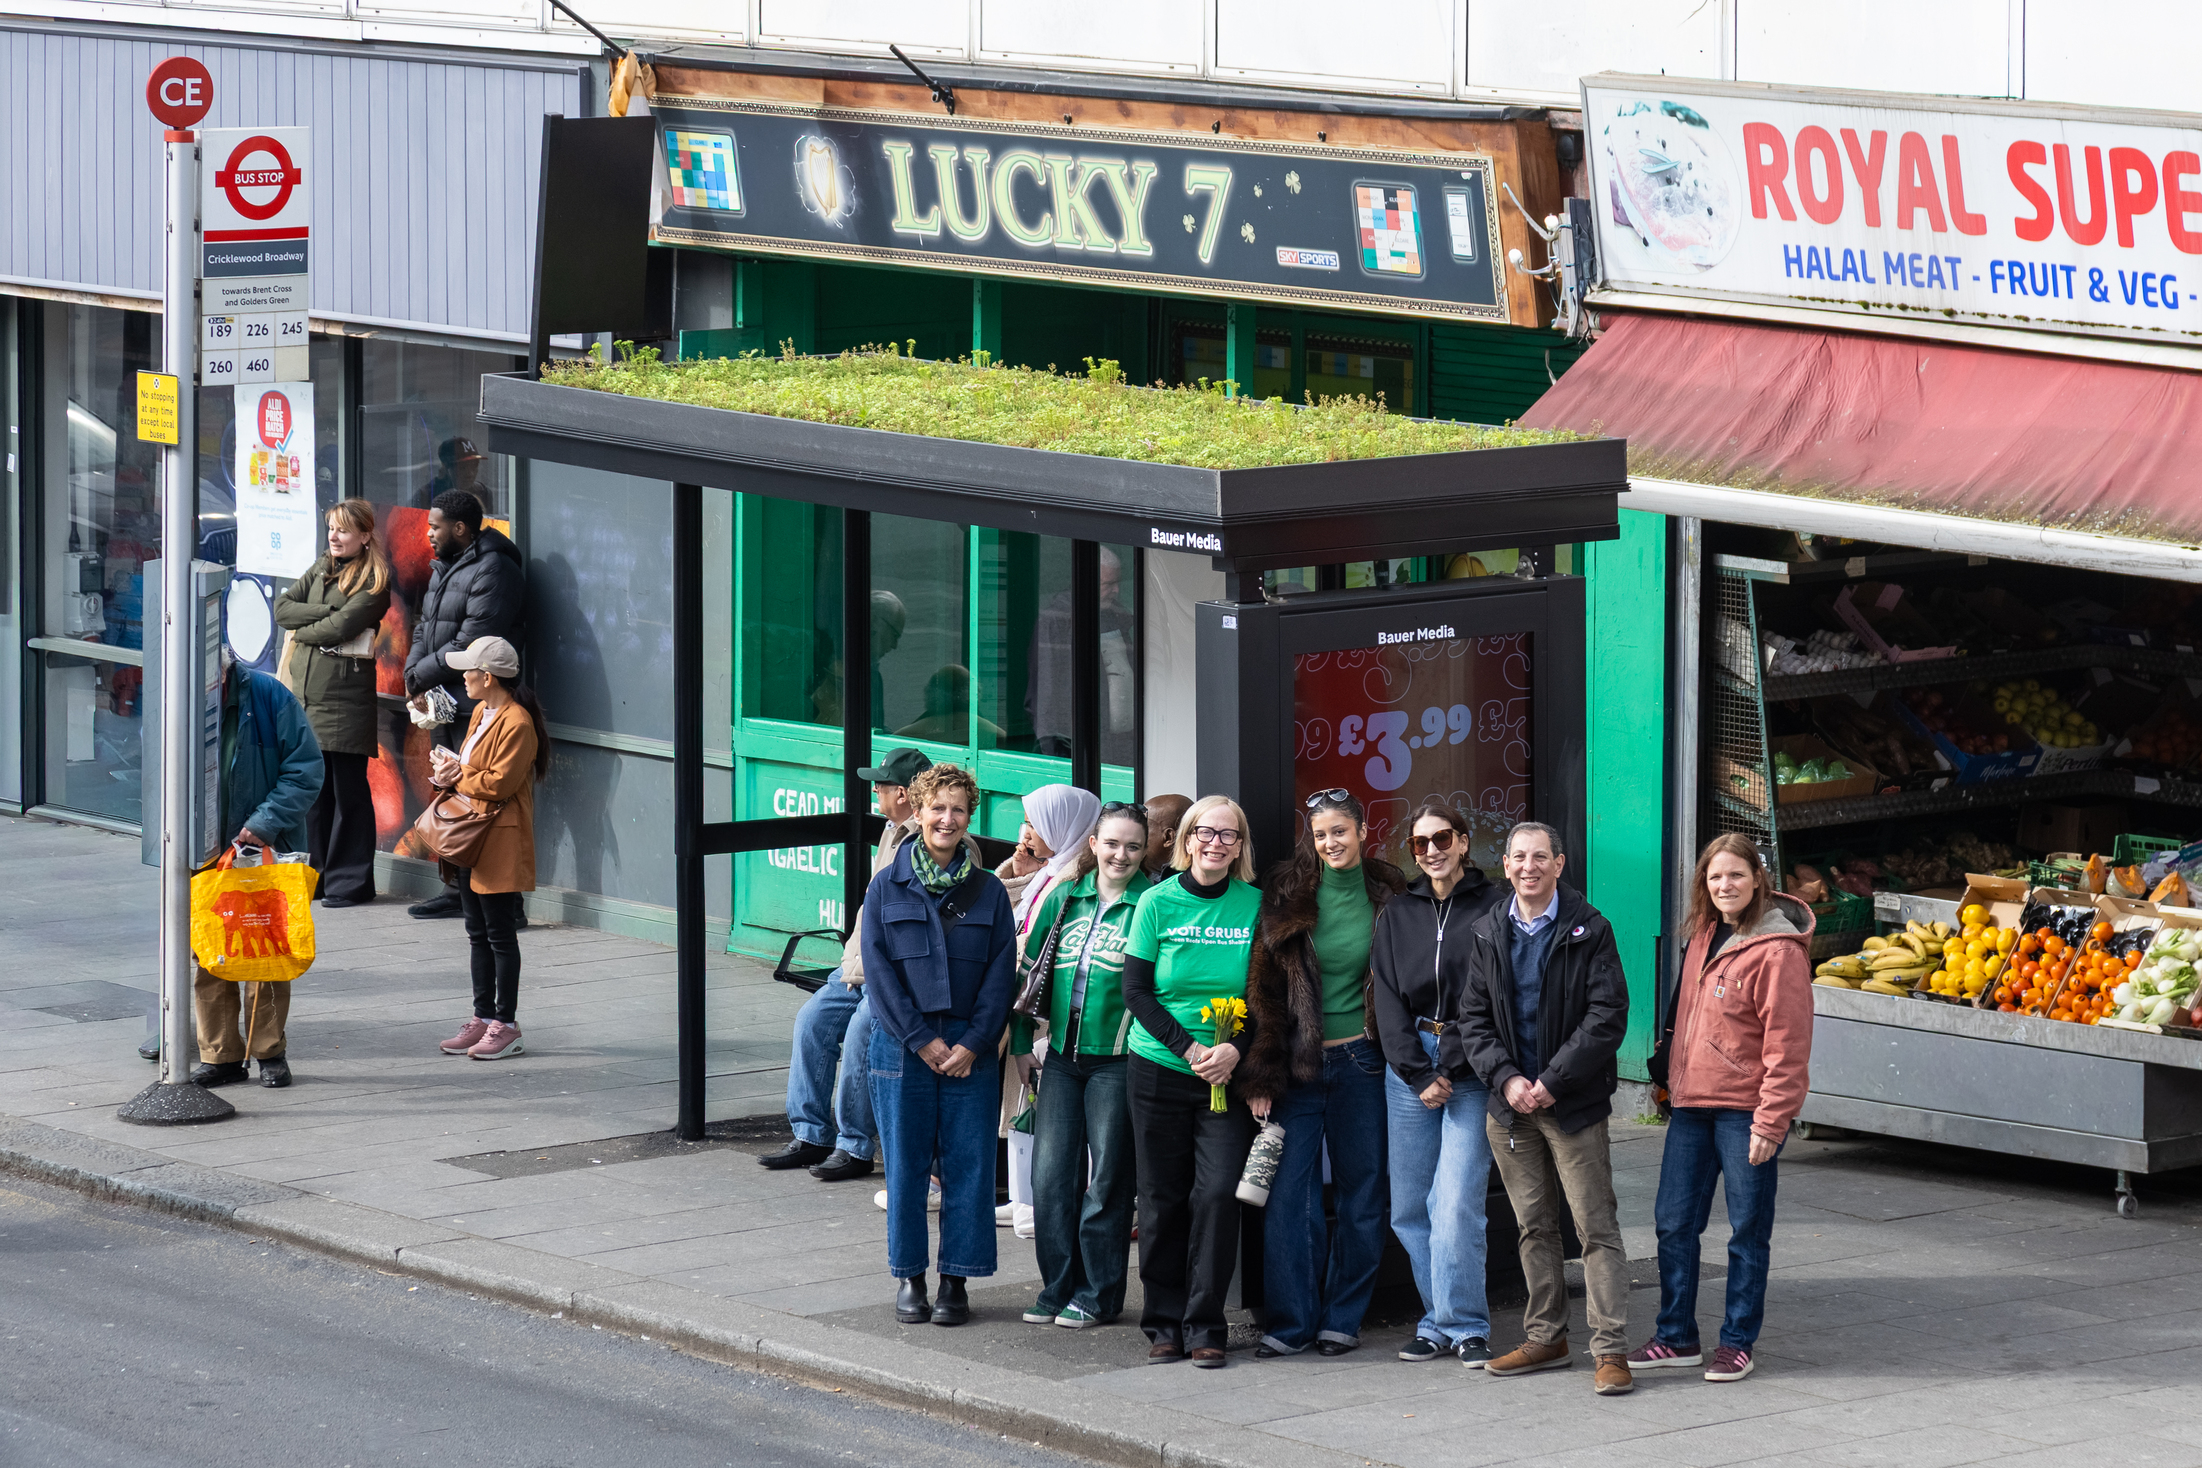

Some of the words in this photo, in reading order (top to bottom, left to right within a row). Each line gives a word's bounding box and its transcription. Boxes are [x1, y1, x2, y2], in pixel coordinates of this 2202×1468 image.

[160, 77, 203, 107] CE
[234, 172, 255, 184] BUS
[257, 171, 285, 184] STOP
[1741, 121, 1987, 236] ROYAL
[2006, 139, 2202, 254] SUPE
[883, 141, 1156, 256] LUCKY
[1186, 165, 1231, 263] 7
[207, 253, 263, 265] Cricklewood
[264, 251, 305, 264] Broadway
[1280, 251, 1297, 262] SKY
[1299, 252, 1337, 266] SPORTS
[1783, 243, 1875, 285] HALAL
[1883, 251, 1962, 292] MEAT
[1990, 259, 2077, 299] FRUIT
[2089, 266, 2111, 303] &
[2118, 270, 2180, 309] VEG
[222, 286, 251, 295] towards
[252, 286, 272, 294] Brent
[272, 285, 292, 293] Cross
[224, 298, 239, 306] and
[240, 298, 267, 306] Golders
[268, 296, 290, 304] Green
[210, 325, 232, 337] 189
[246, 323, 269, 336] 226
[281, 321, 303, 335] 245
[209, 360, 233, 373] 260
[246, 358, 269, 371] 460
[140, 389, 149, 399] No
[150, 391, 175, 404] stopping
[141, 405, 148, 413] at
[149, 406, 159, 416] any
[161, 407, 173, 416] time
[267, 398, 282, 411] ALDI
[265, 409, 284, 422] PRICE
[140, 417, 160, 428] except
[161, 418, 175, 429] local
[265, 421, 285, 433] MATCH
[149, 428, 166, 440] buses
[1151, 528, 1185, 546] Bauer
[1186, 532, 1222, 552] Media
[1378, 631, 1415, 644] Bauer
[1417, 624, 1456, 641] Media
[1338, 703, 1472, 791] £3.99
[773, 788, 819, 817] CEAD
[1167, 926, 1202, 937] VOTE
[1204, 926, 1250, 939] GRUBS
